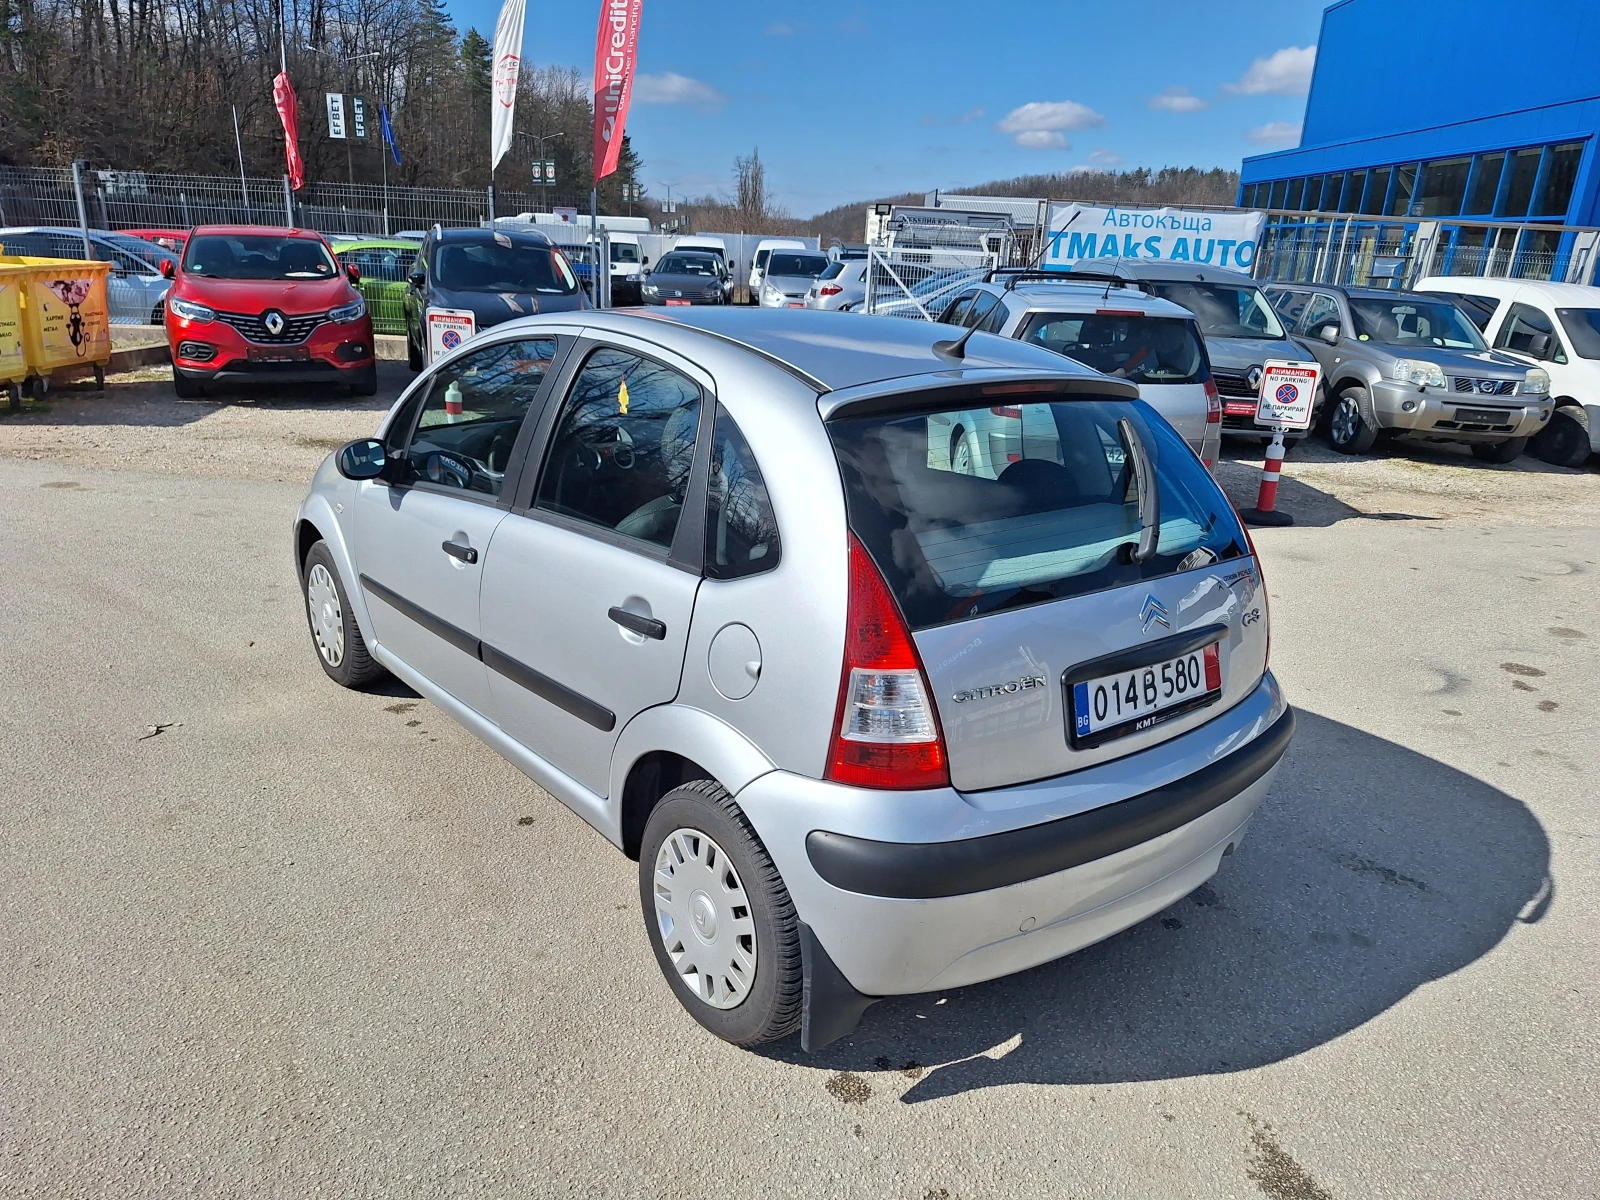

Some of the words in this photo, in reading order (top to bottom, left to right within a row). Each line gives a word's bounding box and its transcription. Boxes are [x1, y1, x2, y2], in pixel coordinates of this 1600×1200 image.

[605, 0, 628, 112] UniCredit
[331, 97, 341, 135] EFBET
[354, 98, 364, 136] EFBET
[1103, 208, 1212, 234] Автокъща
[1048, 231, 1161, 259] TMAkS
[1170, 237, 1255, 267] AUTO
[1271, 368, 1312, 377] ВНИМАНИЕ!
[953, 675, 1047, 703] CITROËN
[1077, 716, 1089, 728] BG
[1136, 716, 1156, 730] KMT
